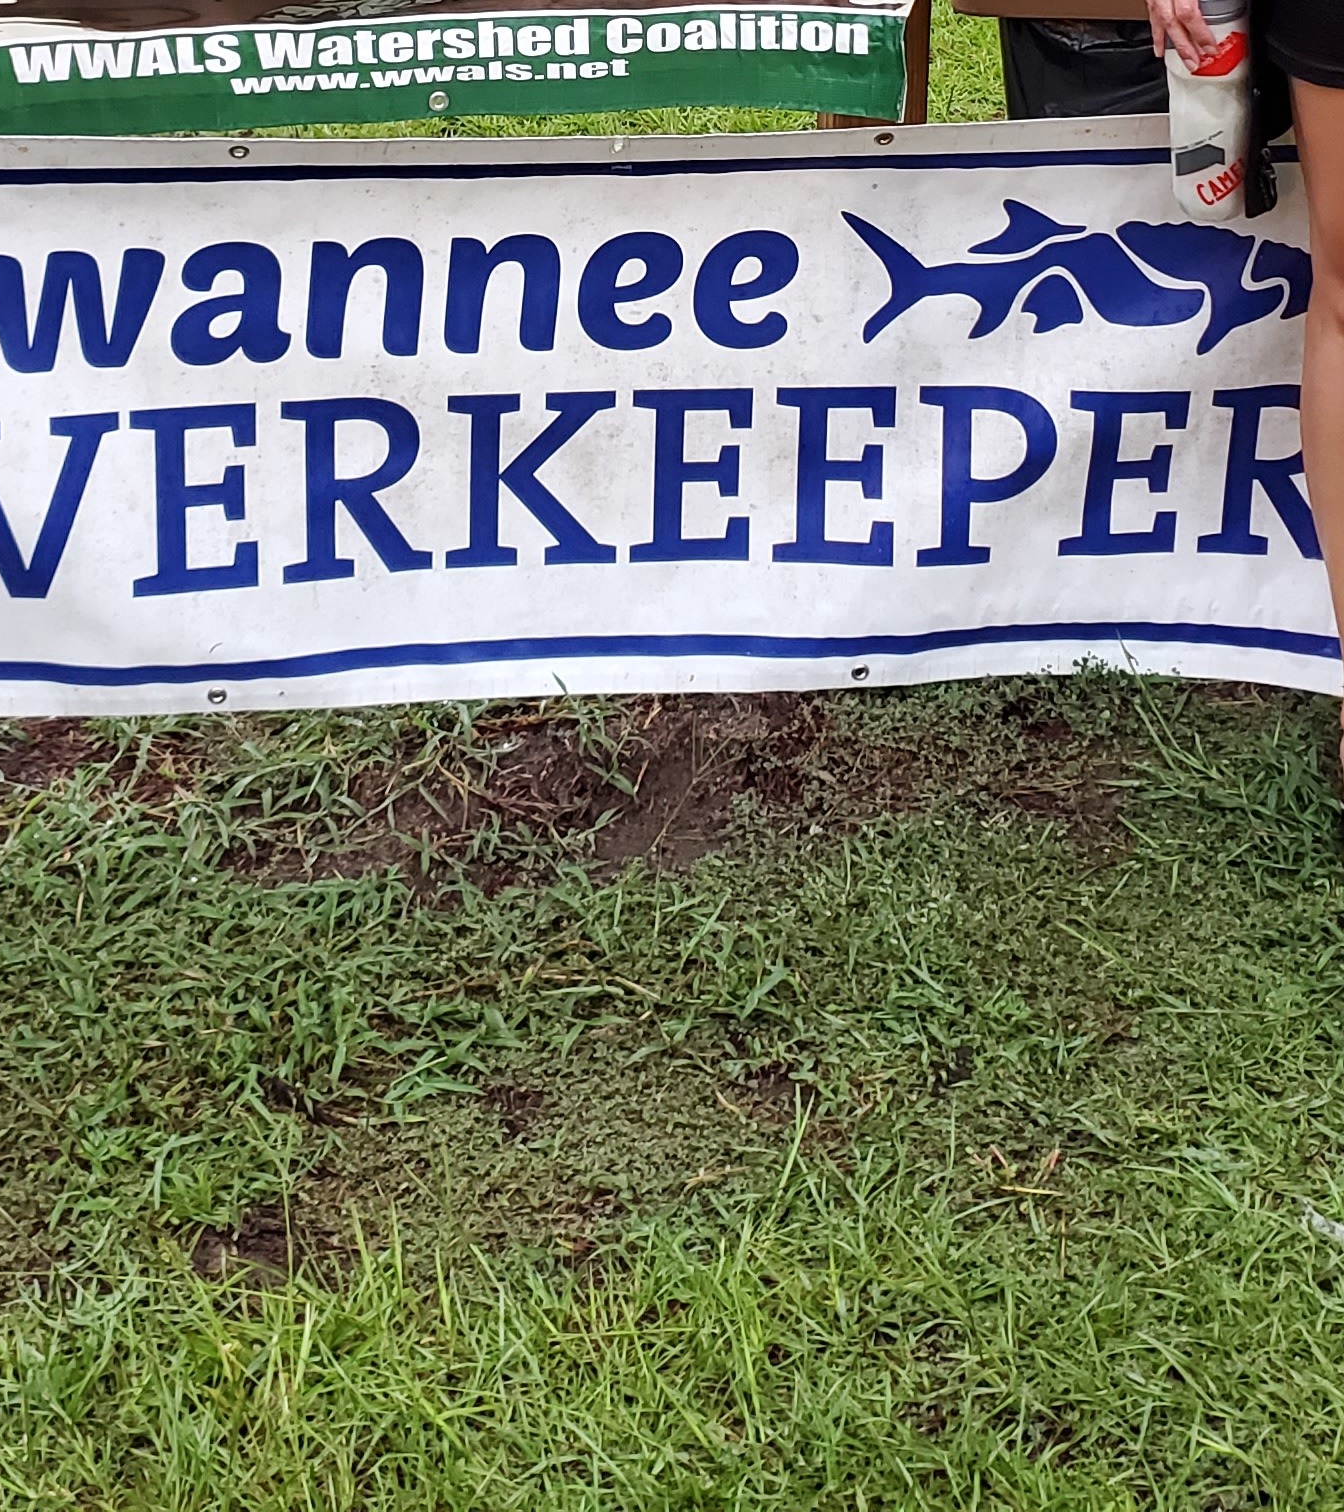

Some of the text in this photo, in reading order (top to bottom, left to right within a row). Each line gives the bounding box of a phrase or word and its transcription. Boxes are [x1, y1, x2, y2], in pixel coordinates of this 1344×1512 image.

[9, 14, 868, 83] WWALS Watershed Coalition
[230, 59, 629, 94] www.wwals.net
